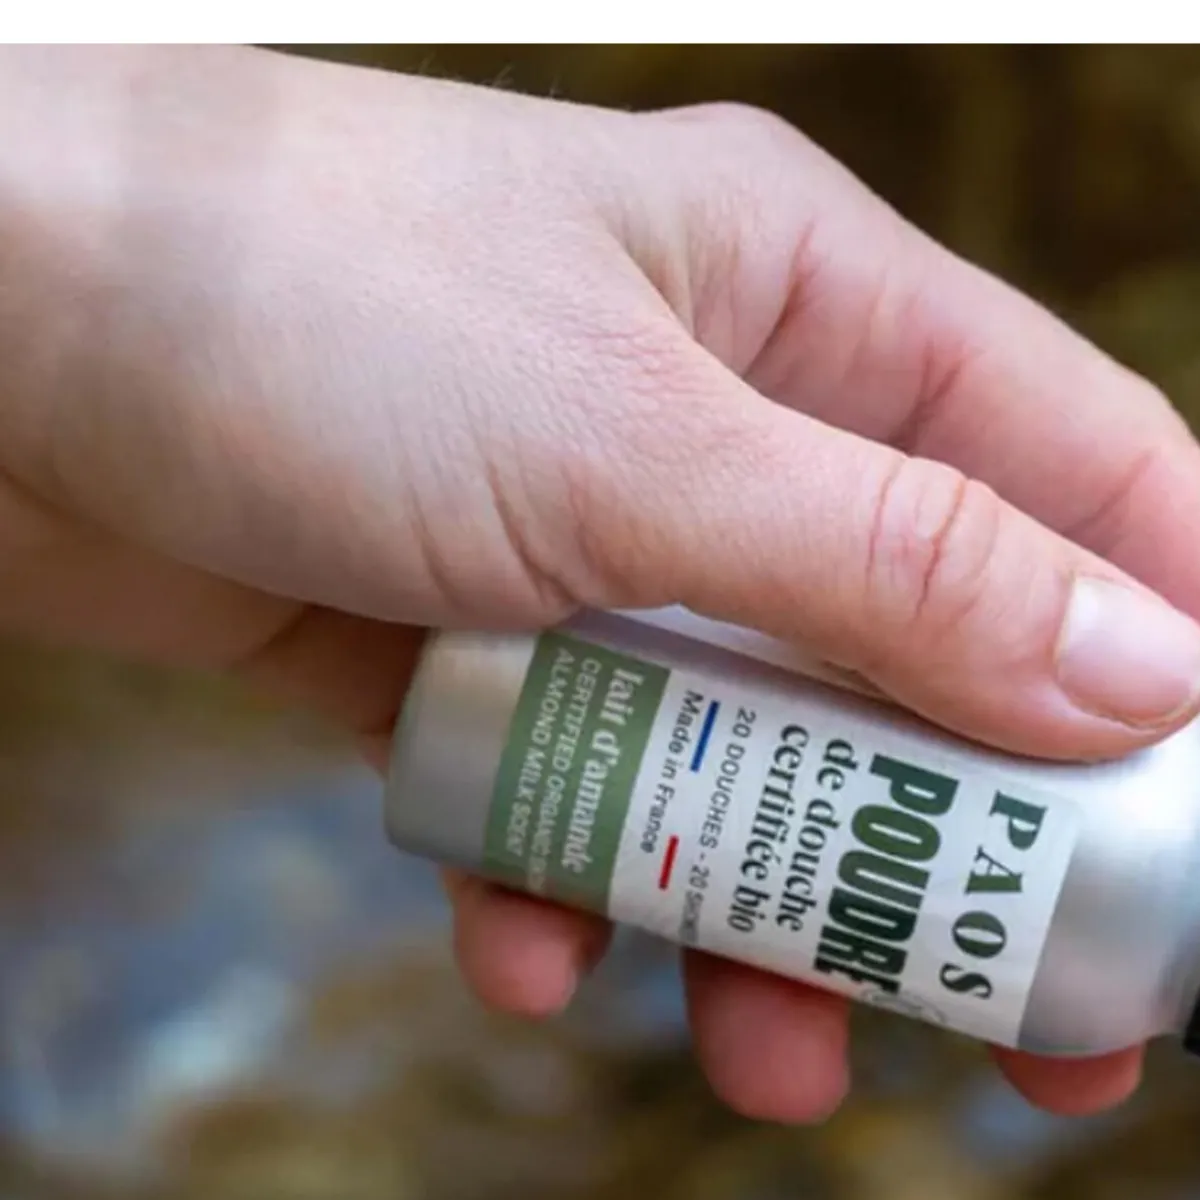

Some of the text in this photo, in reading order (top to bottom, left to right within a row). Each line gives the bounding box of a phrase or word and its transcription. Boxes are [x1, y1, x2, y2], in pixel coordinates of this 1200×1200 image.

[531, 647, 576, 746] ALMOND
[552, 656, 602, 772] CERTIFIED
[600, 667, 645, 726] lait
[732, 706, 756, 738] 20
[517, 746, 547, 803] MILK
[639, 690, 705, 854] Made in France
[699, 743, 746, 849] DOUCHES
[726, 723, 810, 932] certifiée bio
[689, 864, 710, 889] 20
[775, 738, 859, 932] de douche
[813, 753, 960, 994] POUDRE
[939, 790, 1048, 1000] PAOS
